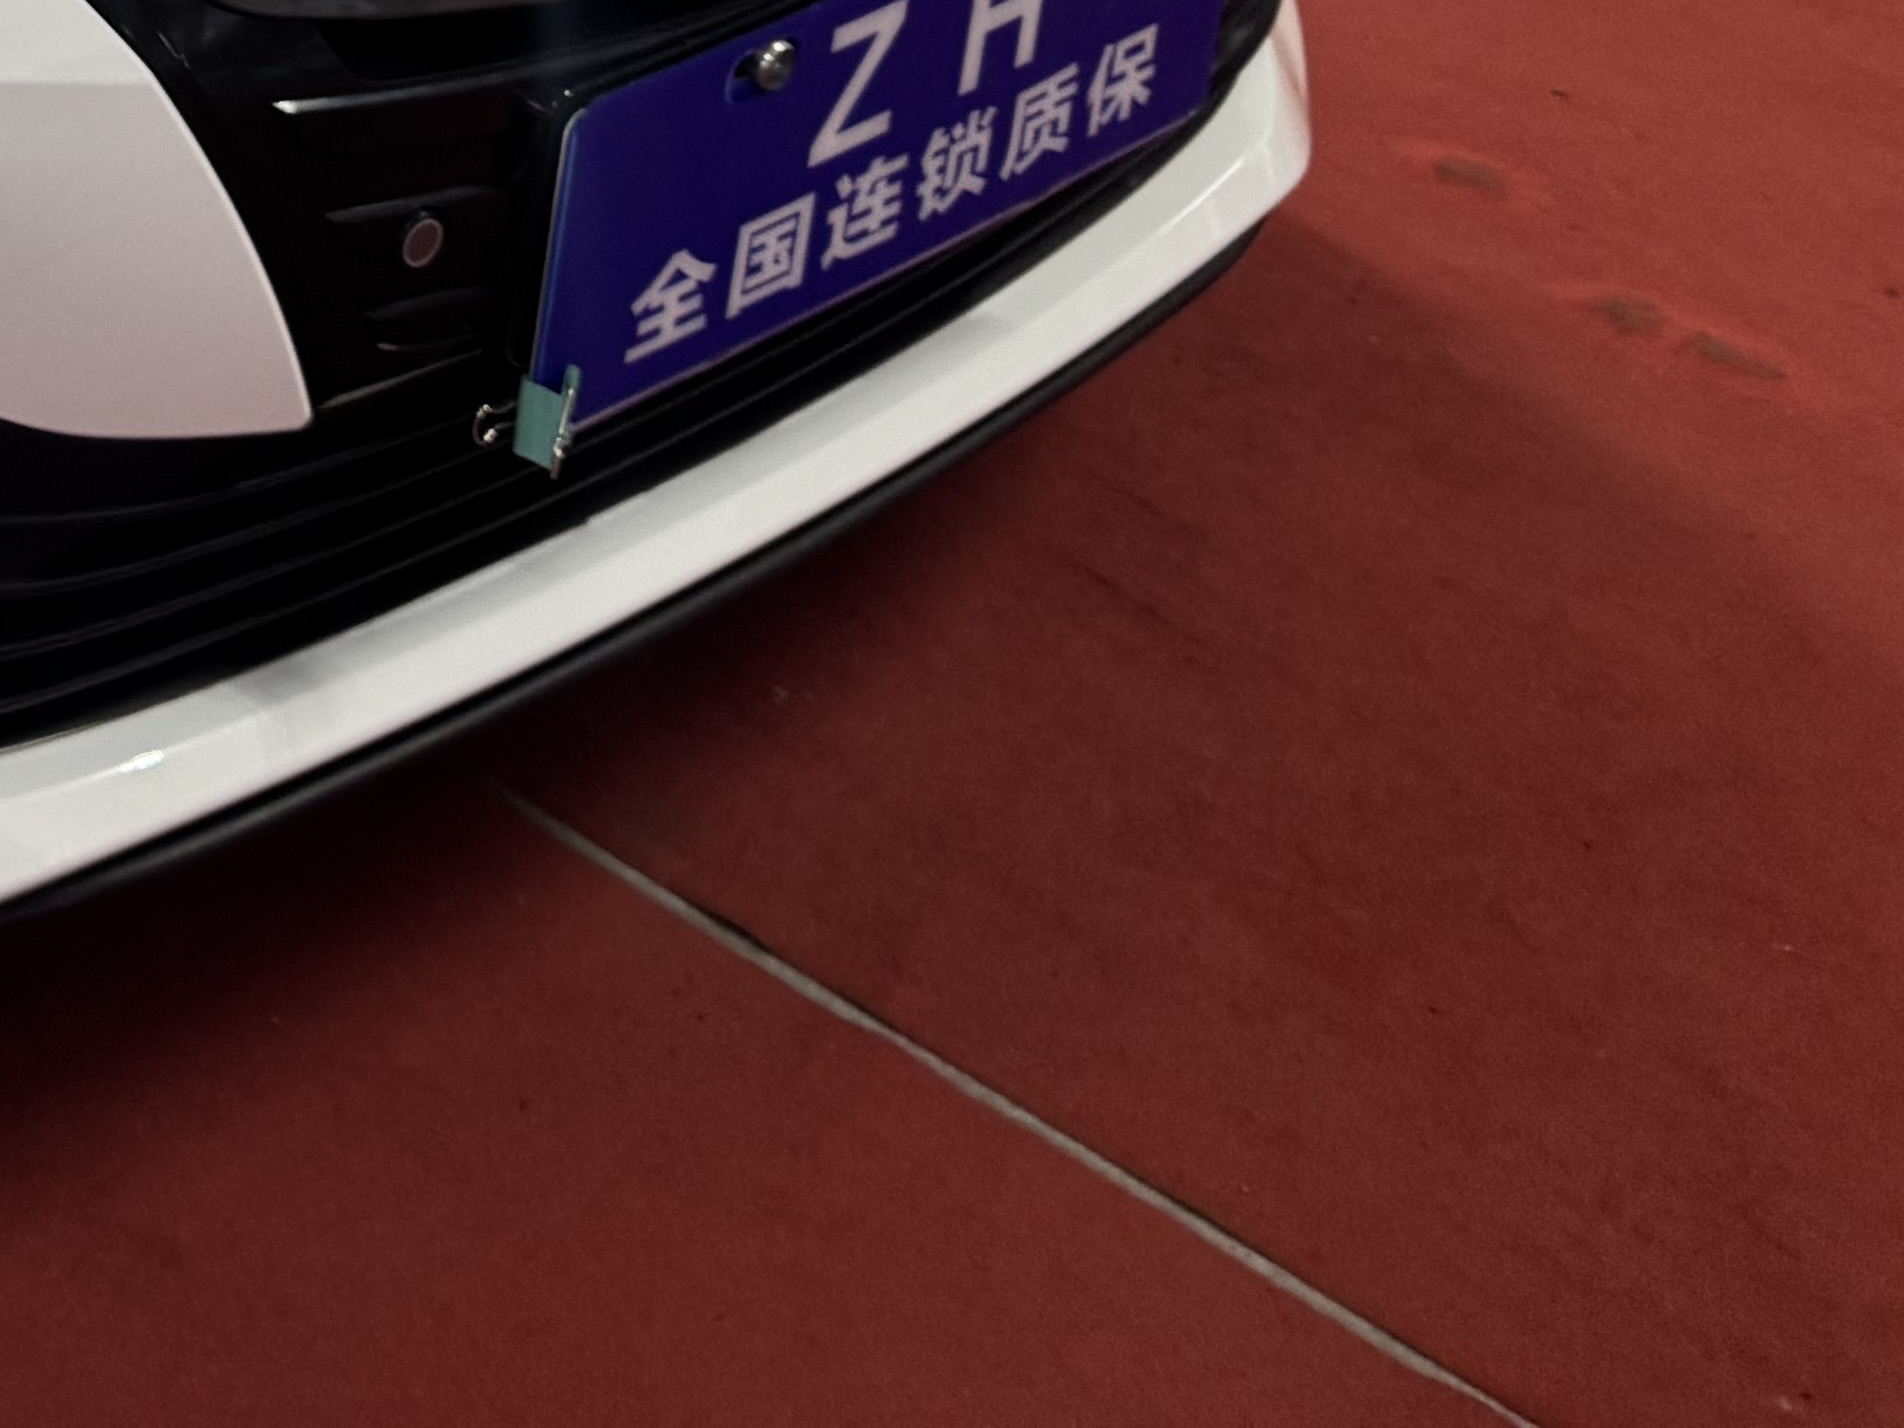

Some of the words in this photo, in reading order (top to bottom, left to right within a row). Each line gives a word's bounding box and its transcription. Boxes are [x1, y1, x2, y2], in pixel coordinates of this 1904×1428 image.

[622, 23, 1160, 363] 全国连锁质保
